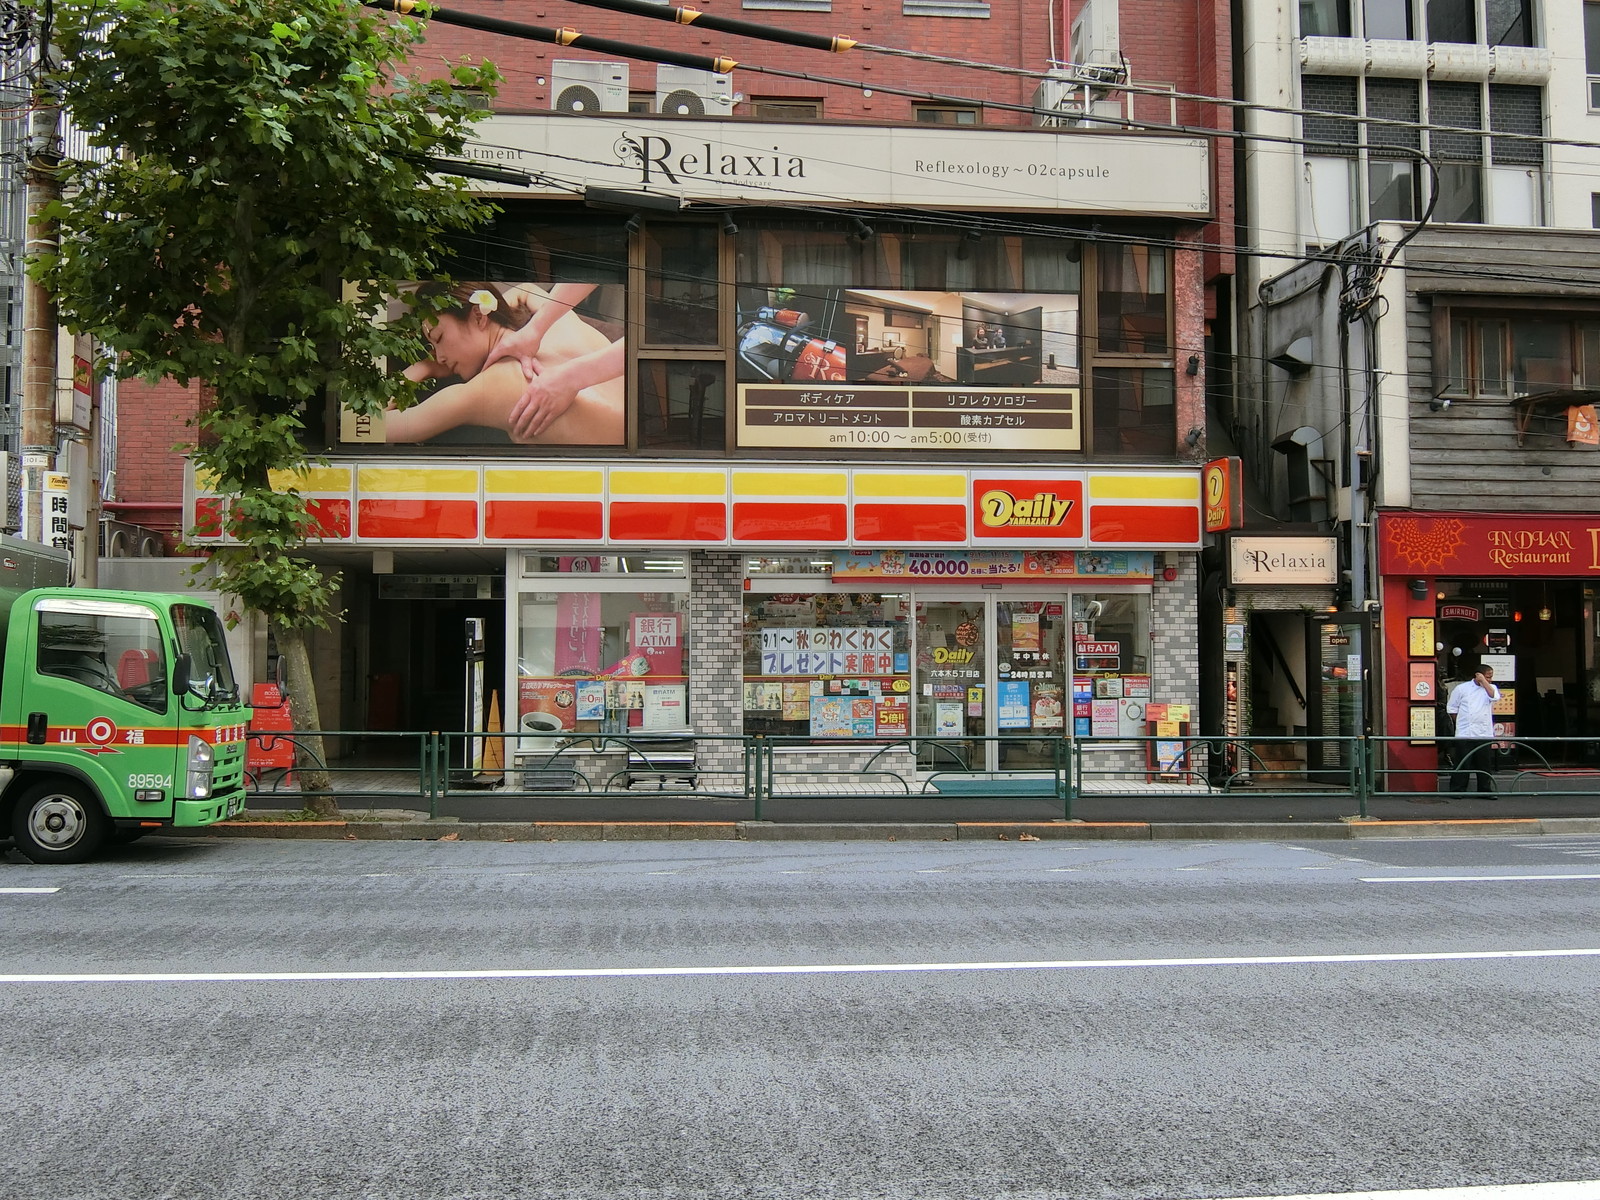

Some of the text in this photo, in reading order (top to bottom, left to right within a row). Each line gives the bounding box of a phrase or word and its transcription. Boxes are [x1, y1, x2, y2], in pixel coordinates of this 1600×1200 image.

[639, 135, 806, 185] Relaxia
[914, 160, 1009, 178] Reflexology
[799, 392, 855, 405] ボディケア
[947, 394, 1037, 407] リフレクソロジー
[773, 412, 883, 425] アロマトリートメント
[959, 413, 1026, 427] 酸素カプセル
[829, 430, 891, 443] am10:00
[981, 490, 1074, 527] Daily
[1010, 517, 1050, 526] YAMAZAKI
[1208, 506, 1226, 526] Daily
[1487, 530, 1576, 550] INDIAN
[1254, 550, 1326, 572] Relaxia
[1488, 549, 1571, 568] Restaurant
[908, 560, 968, 574] 40,000
[1445, 608, 1476, 617] SMIRNOFF
[640, 618, 672, 634] 銀行
[640, 635, 672, 646] ATM
[1078, 644, 1118, 652] 銀行ATM
[933, 647, 976, 664] Daily
[764, 652, 892, 674] プレゼント実施中
[930, 670, 980, 678] 六本木5丁目店
[60, 728, 144, 744] 山 福
[128, 774, 172, 788] 89594
